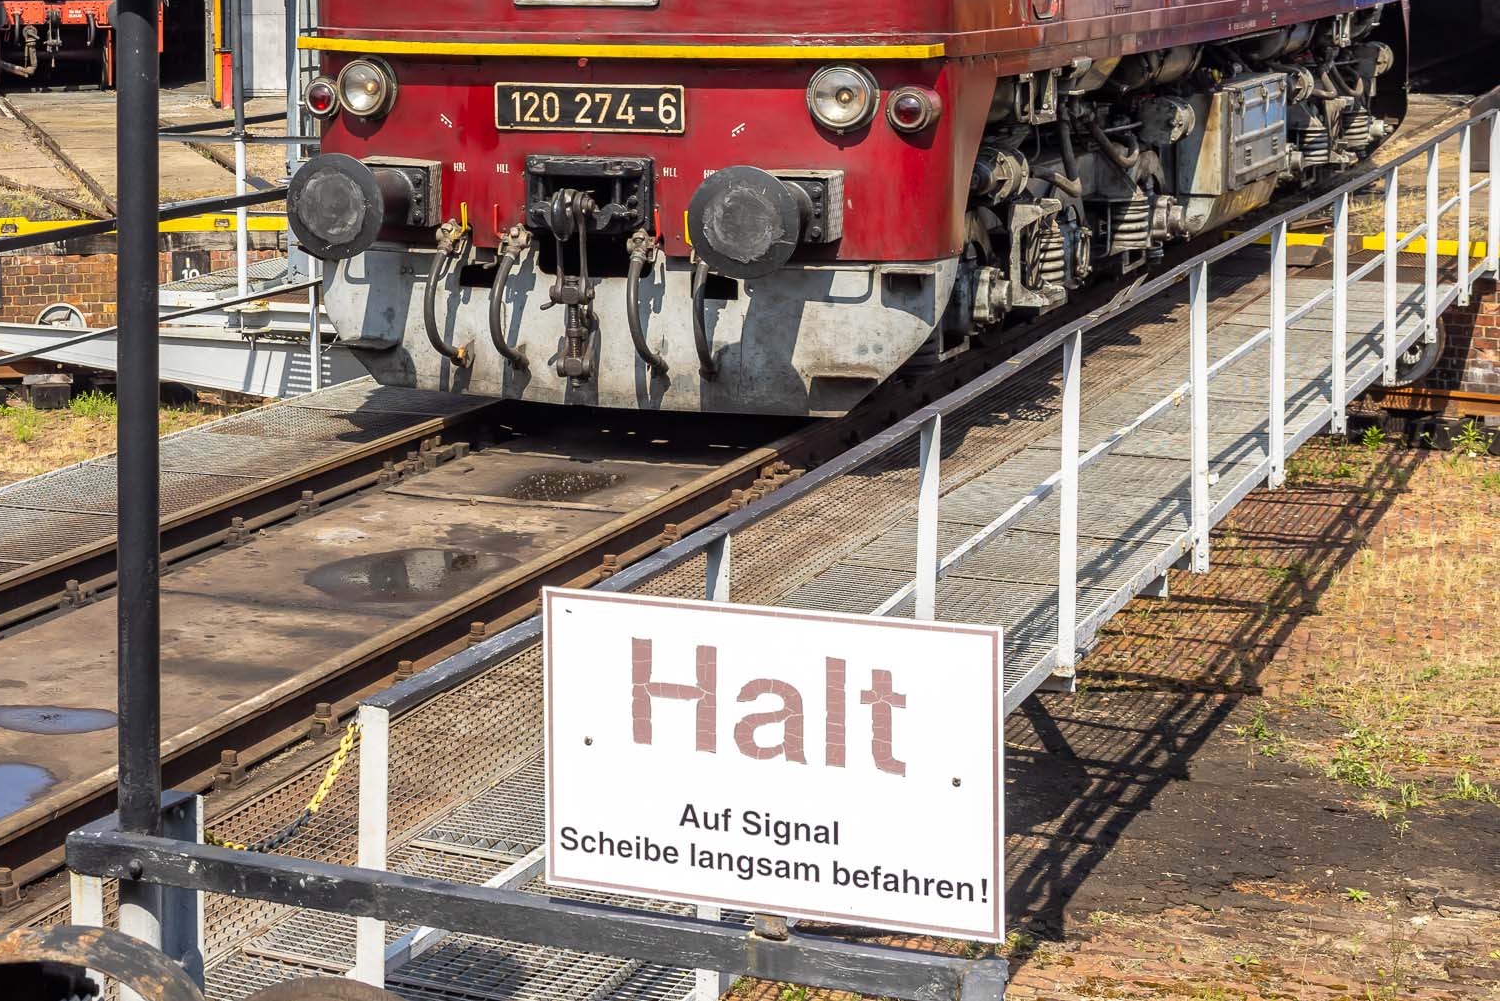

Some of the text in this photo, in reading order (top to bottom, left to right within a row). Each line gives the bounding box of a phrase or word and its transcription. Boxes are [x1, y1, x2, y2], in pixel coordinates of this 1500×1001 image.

[511, 91, 677, 125] 120 274-6
[631, 636, 907, 778] Halt
[678, 803, 840, 847] Auf Signal
[559, 826, 989, 904] Scheibe langsam befahren!
